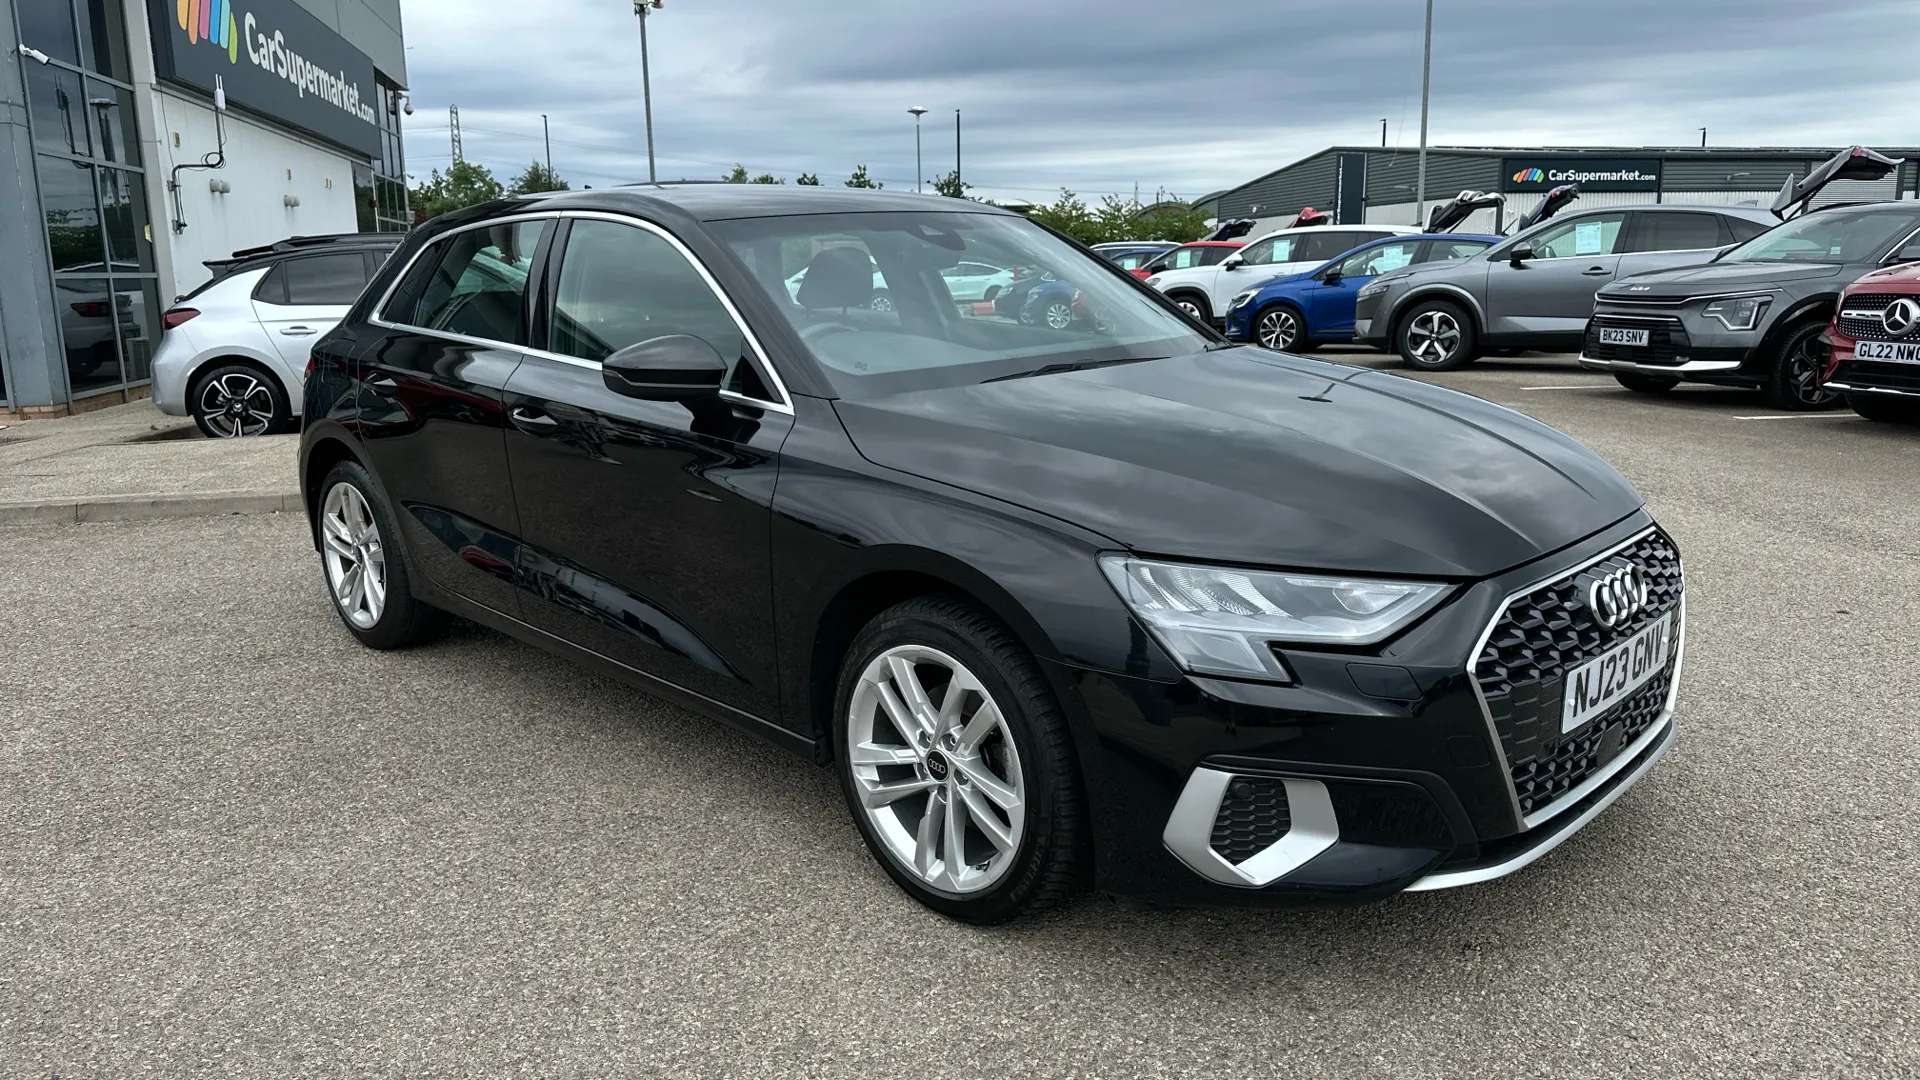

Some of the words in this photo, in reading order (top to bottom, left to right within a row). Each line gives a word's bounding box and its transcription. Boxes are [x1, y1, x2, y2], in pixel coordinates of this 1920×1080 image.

[244, 12, 376, 126] CarSupermarket.com
[1548, 169, 1656, 183] CarSupermarket.com
[1602, 329, 1625, 342] BK23
[1626, 330, 1645, 344] SNV
[1859, 343, 1893, 359] GL22
[1572, 646, 1630, 718] NJ23
[1632, 620, 1665, 681] GNV
